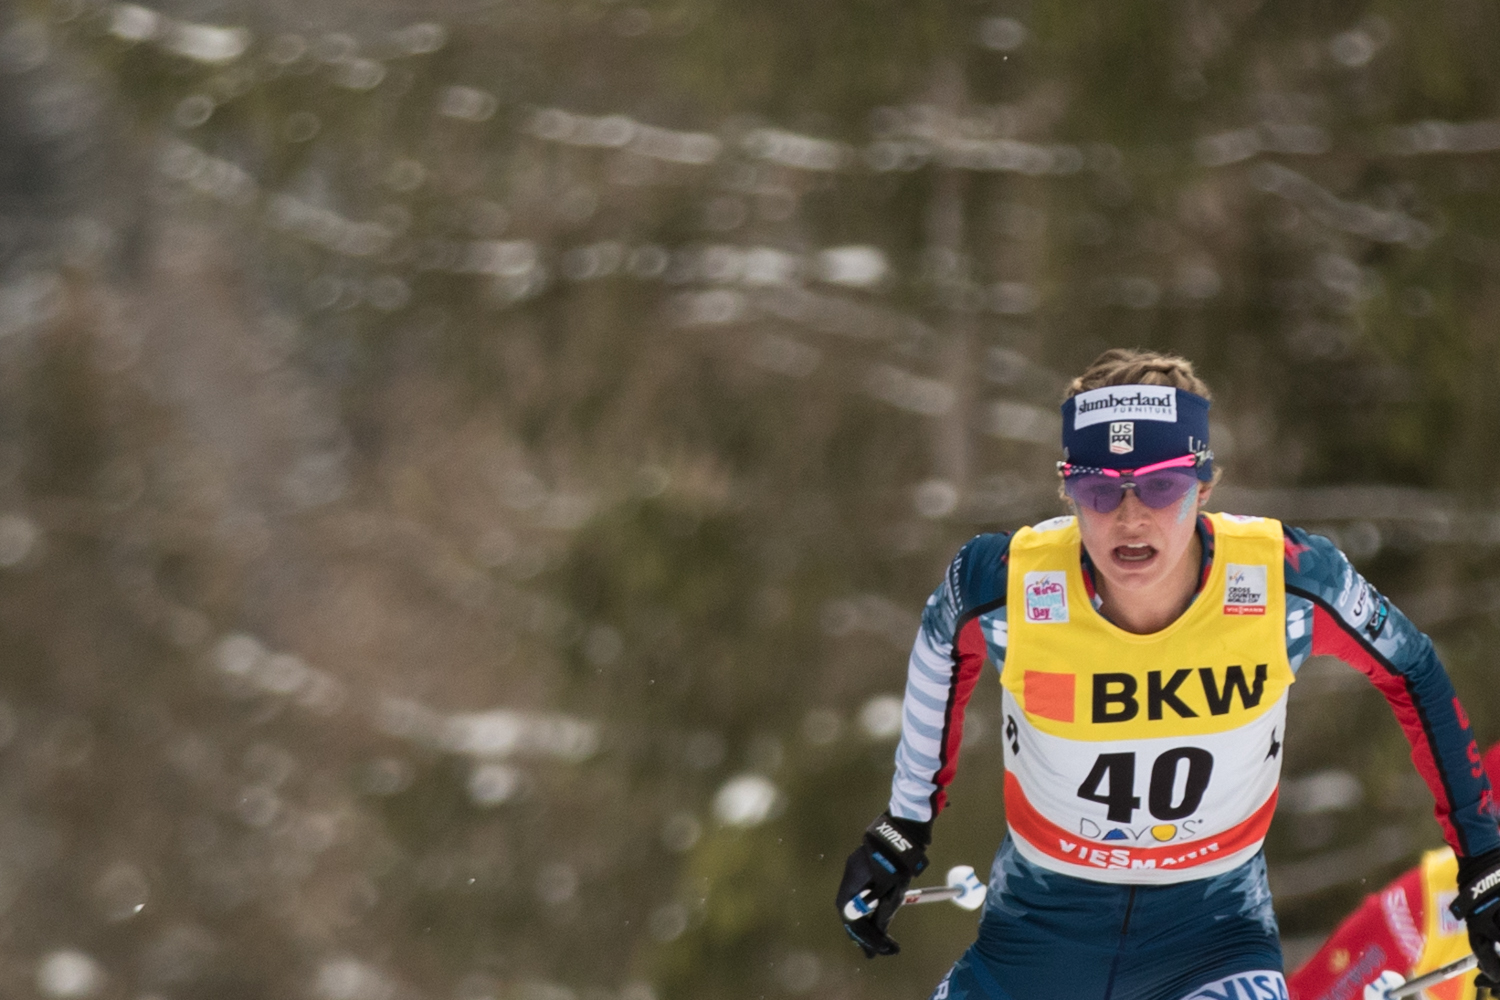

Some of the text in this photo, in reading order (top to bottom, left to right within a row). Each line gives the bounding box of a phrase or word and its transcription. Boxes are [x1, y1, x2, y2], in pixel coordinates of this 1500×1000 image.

[1078, 392, 1172, 415] slumberland
[1113, 406, 1172, 415] FURNITURE
[1112, 424, 1132, 434] US
[1032, 607, 1050, 619] Day
[1092, 664, 1268, 724] BKW
[1077, 746, 1214, 824] 40
